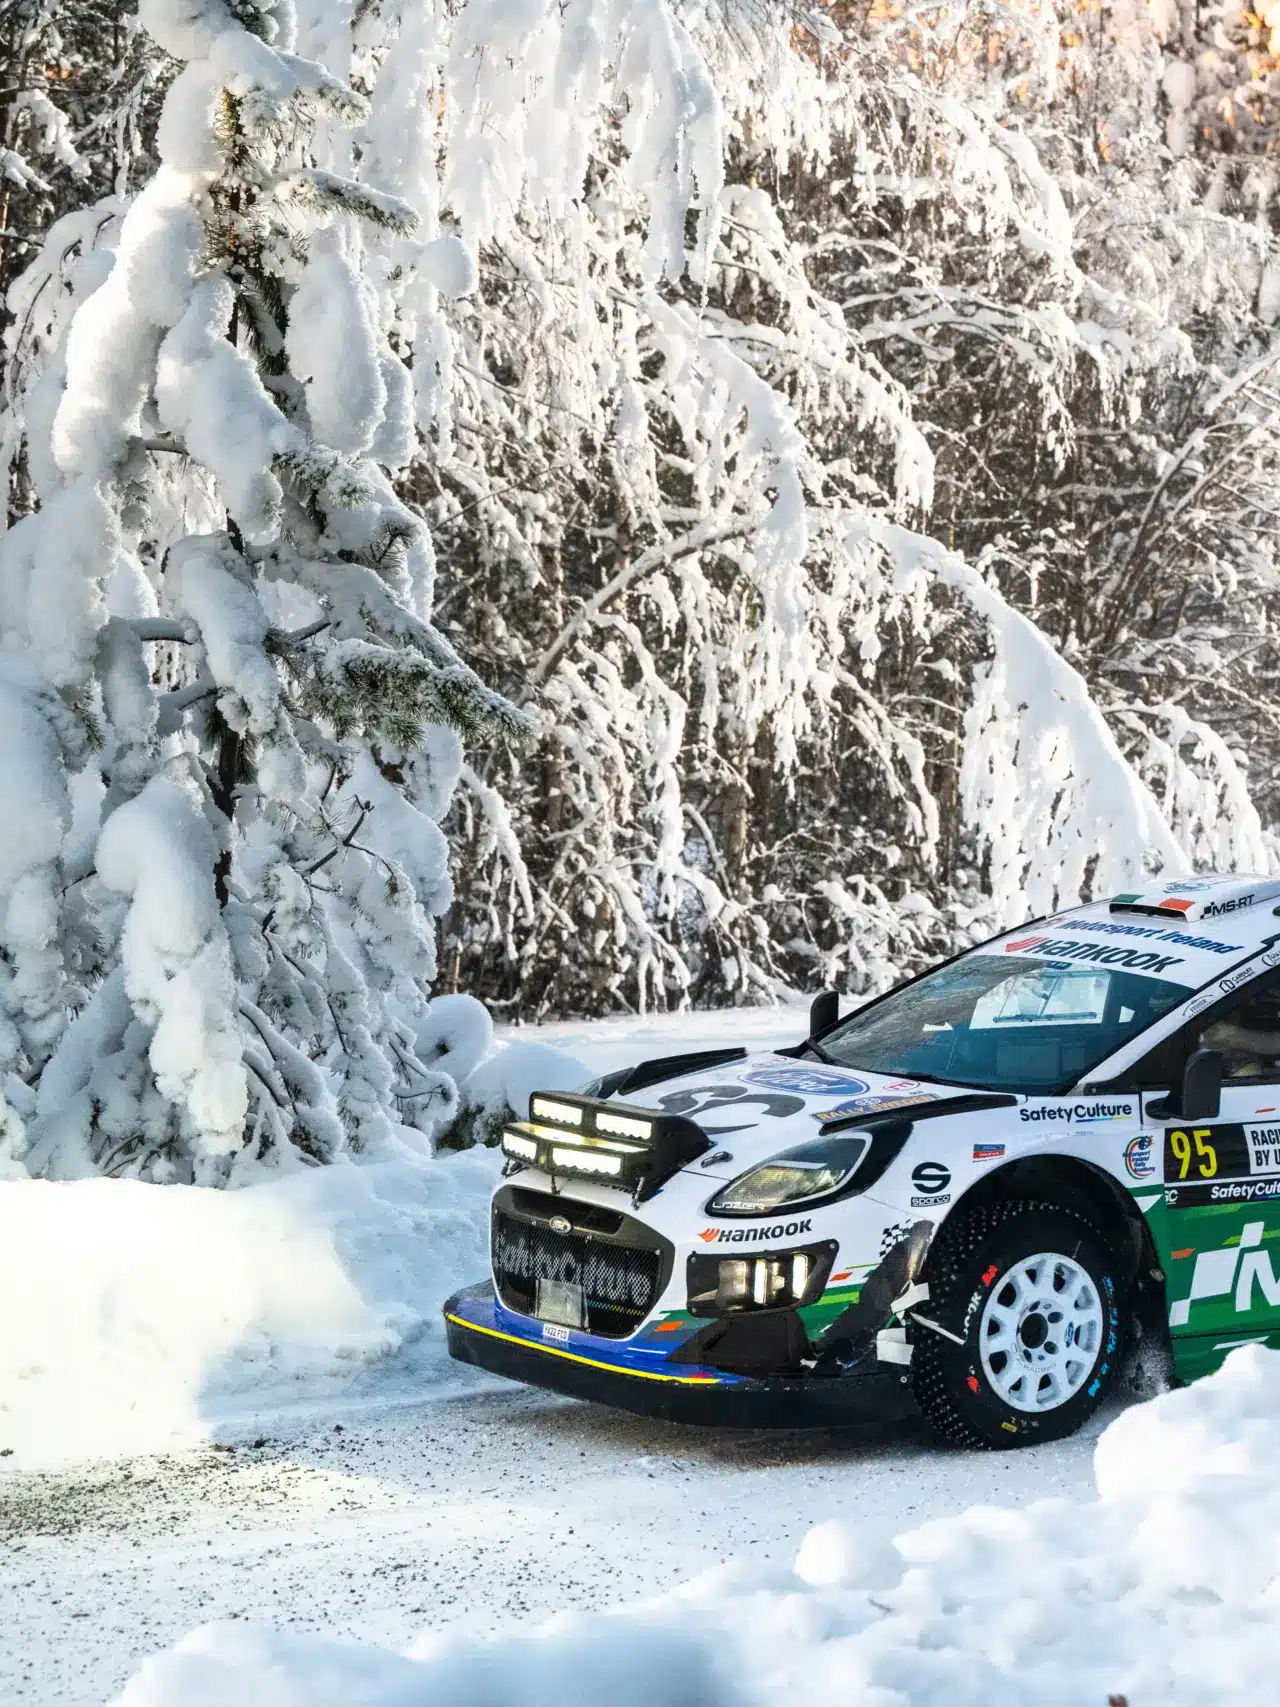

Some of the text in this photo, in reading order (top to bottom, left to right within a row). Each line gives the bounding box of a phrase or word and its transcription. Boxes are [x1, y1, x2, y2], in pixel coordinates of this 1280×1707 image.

[1212, 894, 1255, 916] MS-RT
[1056, 919, 1165, 941] Motorsport
[1158, 930, 1245, 955] Ireland
[817, 1107, 865, 1120] RALLY
[1020, 1103, 1132, 1123] SafetyCulture
[1170, 1130, 1218, 1179] 95
[1255, 1150, 1271, 1166] BY
[911, 1195, 951, 1207] sparco
